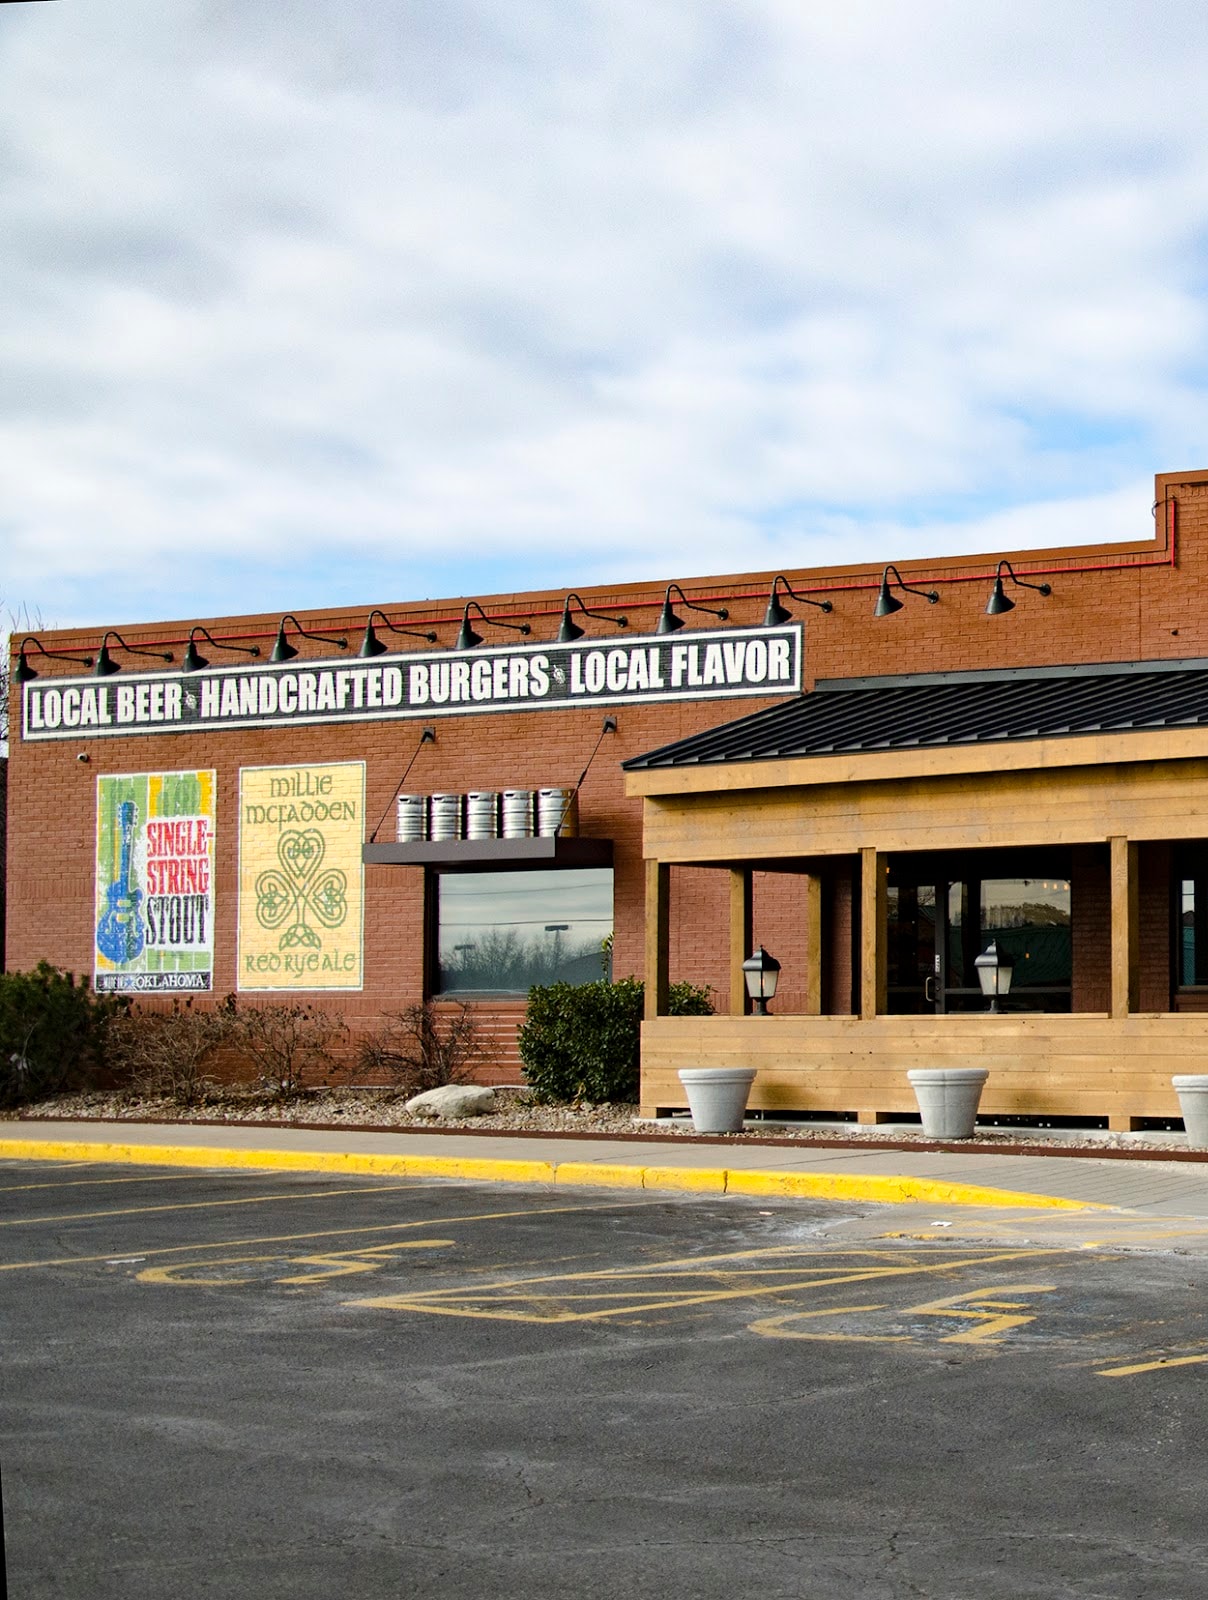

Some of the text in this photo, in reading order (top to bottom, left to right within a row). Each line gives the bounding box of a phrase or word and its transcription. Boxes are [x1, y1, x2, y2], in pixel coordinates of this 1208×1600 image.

[31, 639, 790, 728] LOCAL BEER HANDCRAFTED BURGERS LOCAL FLAVOR
[147, 820, 213, 858] SINGLE-
[147, 858, 209, 895] STRING
[146, 895, 209, 945] STOUT
[136, 974, 204, 989] OKLAHOMA
